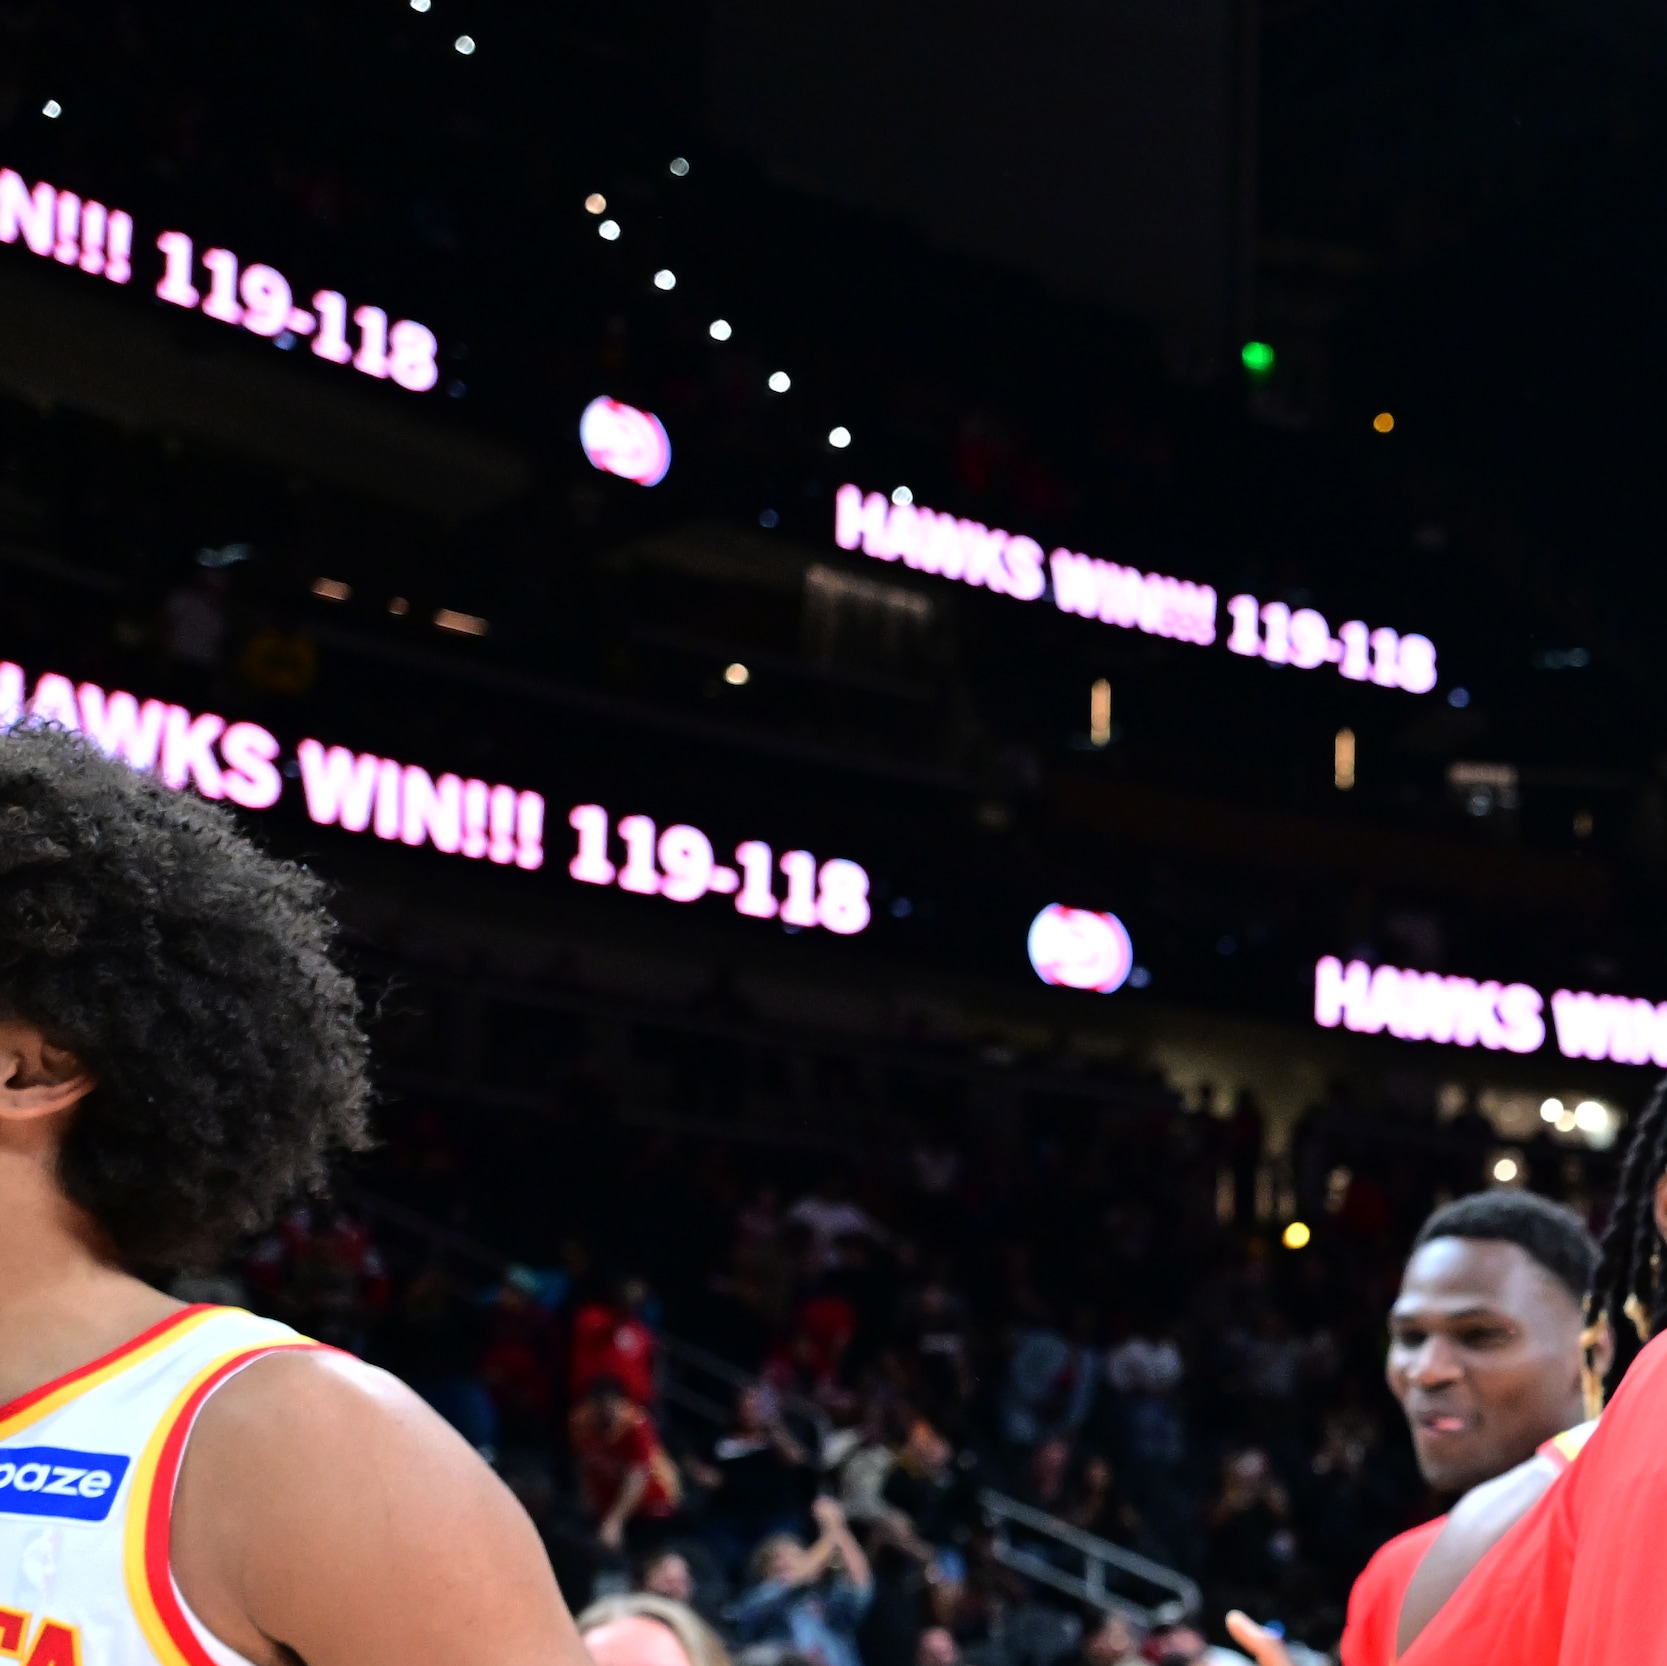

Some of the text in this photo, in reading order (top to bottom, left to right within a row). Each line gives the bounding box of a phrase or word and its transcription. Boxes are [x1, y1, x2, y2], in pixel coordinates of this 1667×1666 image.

[156, 231, 438, 391] 119-118
[1227, 594, 1437, 694] 119-118
[297, 738, 544, 870] WIN!!!
[569, 804, 870, 934] 119-118
[1315, 956, 1546, 1053] HAWKS
